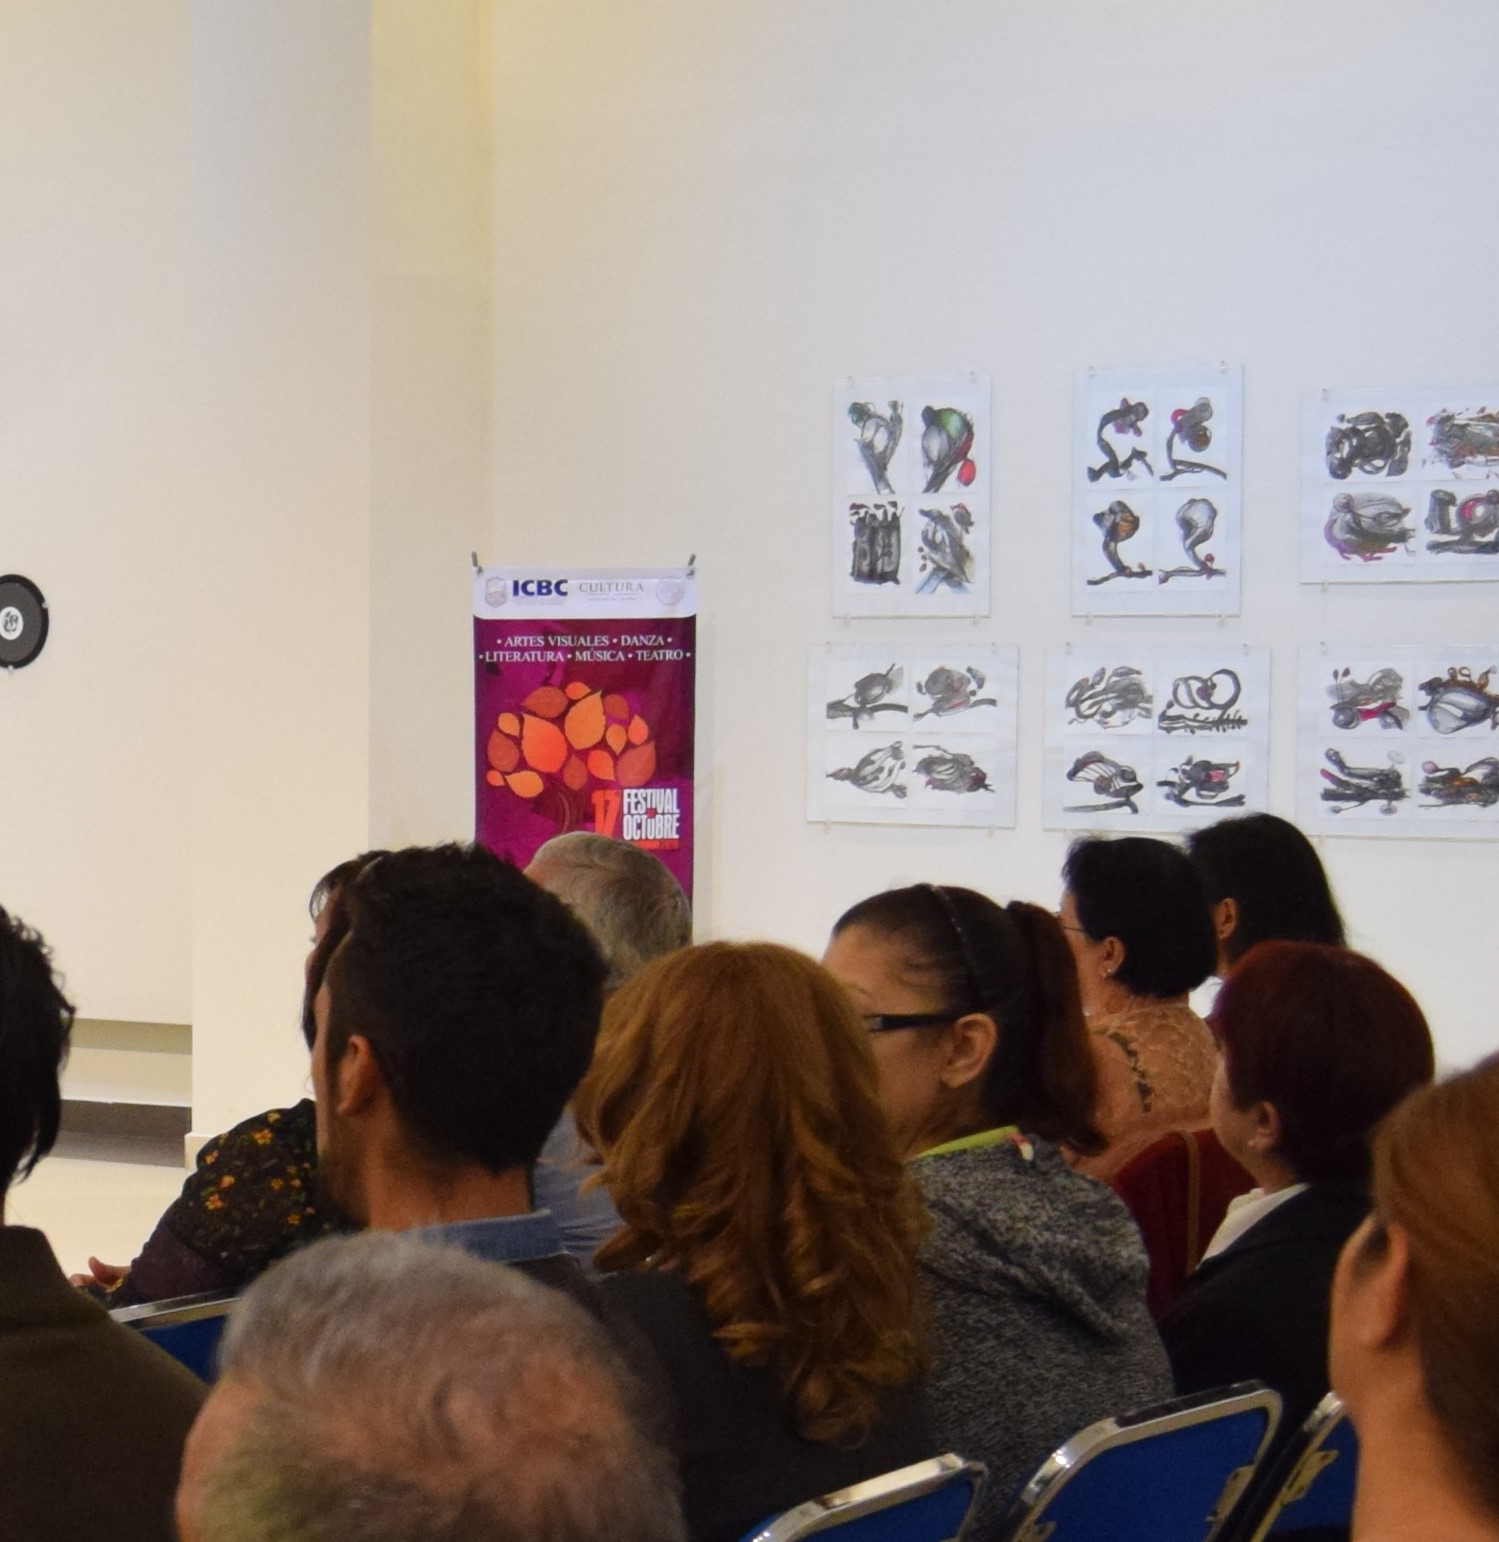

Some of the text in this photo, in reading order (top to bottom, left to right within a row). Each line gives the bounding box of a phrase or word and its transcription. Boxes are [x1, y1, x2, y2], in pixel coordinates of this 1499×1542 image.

[512, 579, 645, 597] ICBC CULTURA
[504, 635, 665, 647] ARTES VISUALES DANZA
[485, 648, 683, 662] LITERATURA MÚSICA TEATRO
[623, 788, 680, 814] FESTIVAL
[623, 814, 680, 841] OCTUBRE
